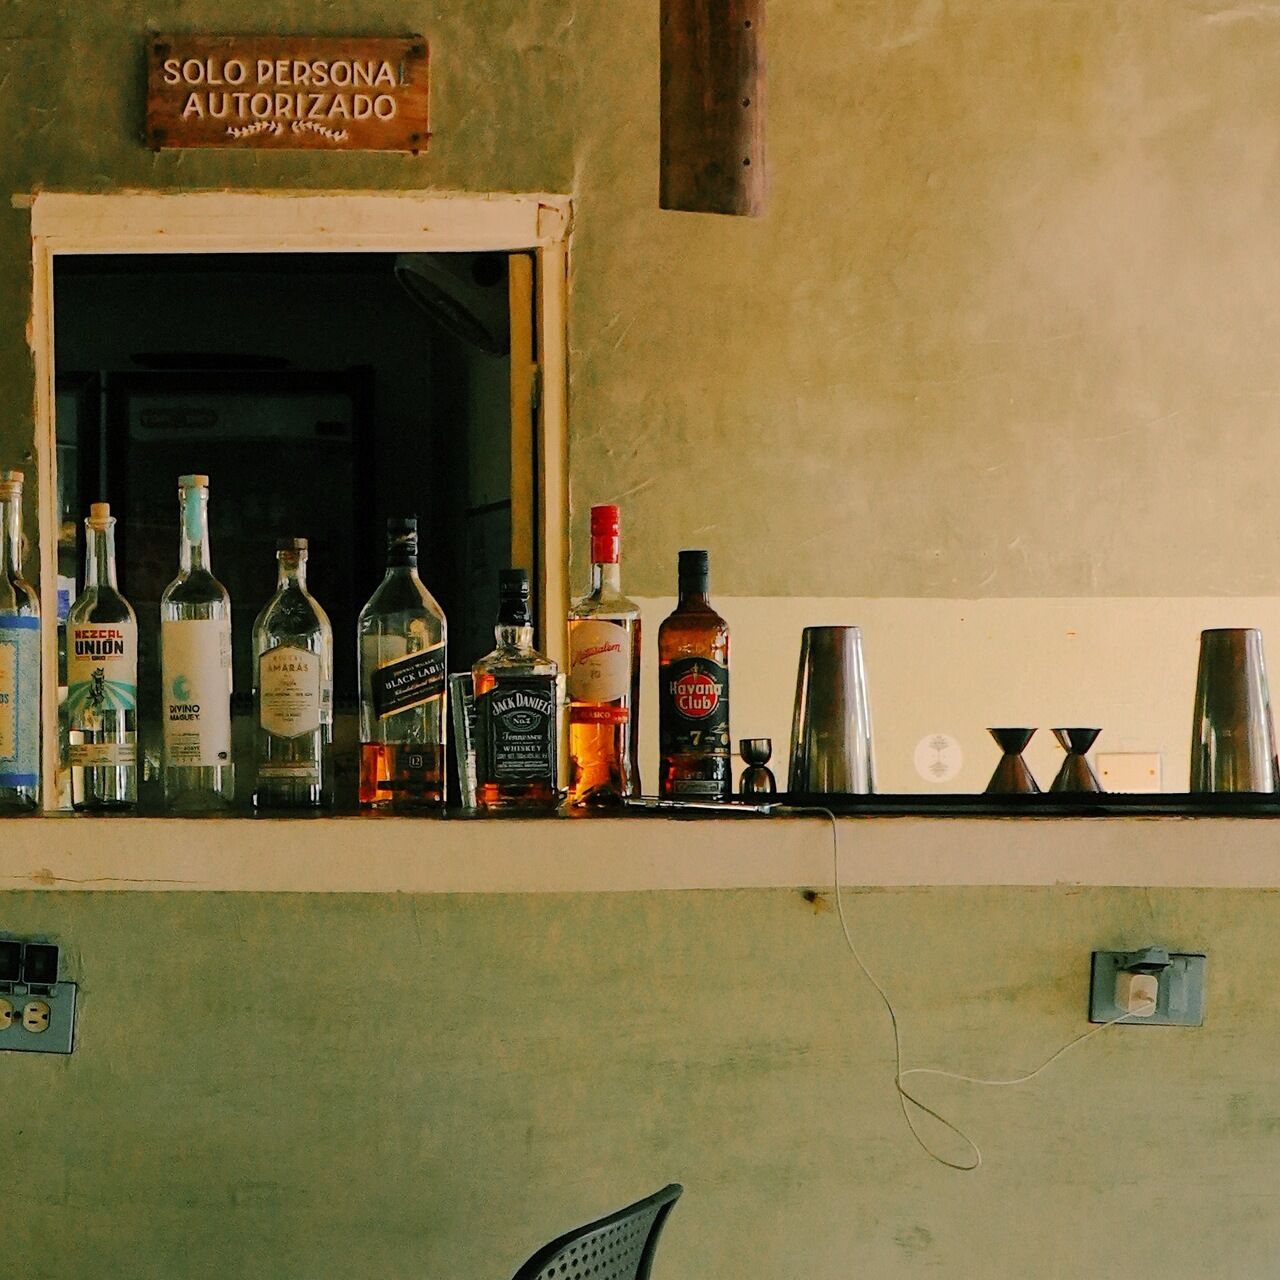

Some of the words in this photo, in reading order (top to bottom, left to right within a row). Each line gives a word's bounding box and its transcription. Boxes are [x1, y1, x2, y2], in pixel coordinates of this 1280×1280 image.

[163, 58, 246, 86] SOLO
[182, 92, 398, 121] AUTORIZADO
[75, 630, 123, 639] MEZCAL
[75, 639, 124, 655] UNIÓN
[385, 673, 416, 690] BLACK
[669, 681, 723, 696] Havana
[170, 704, 200, 713] DIVINO
[492, 697, 516, 716] JACK
[680, 696, 712, 710] Club
[690, 731, 702, 746] 7
